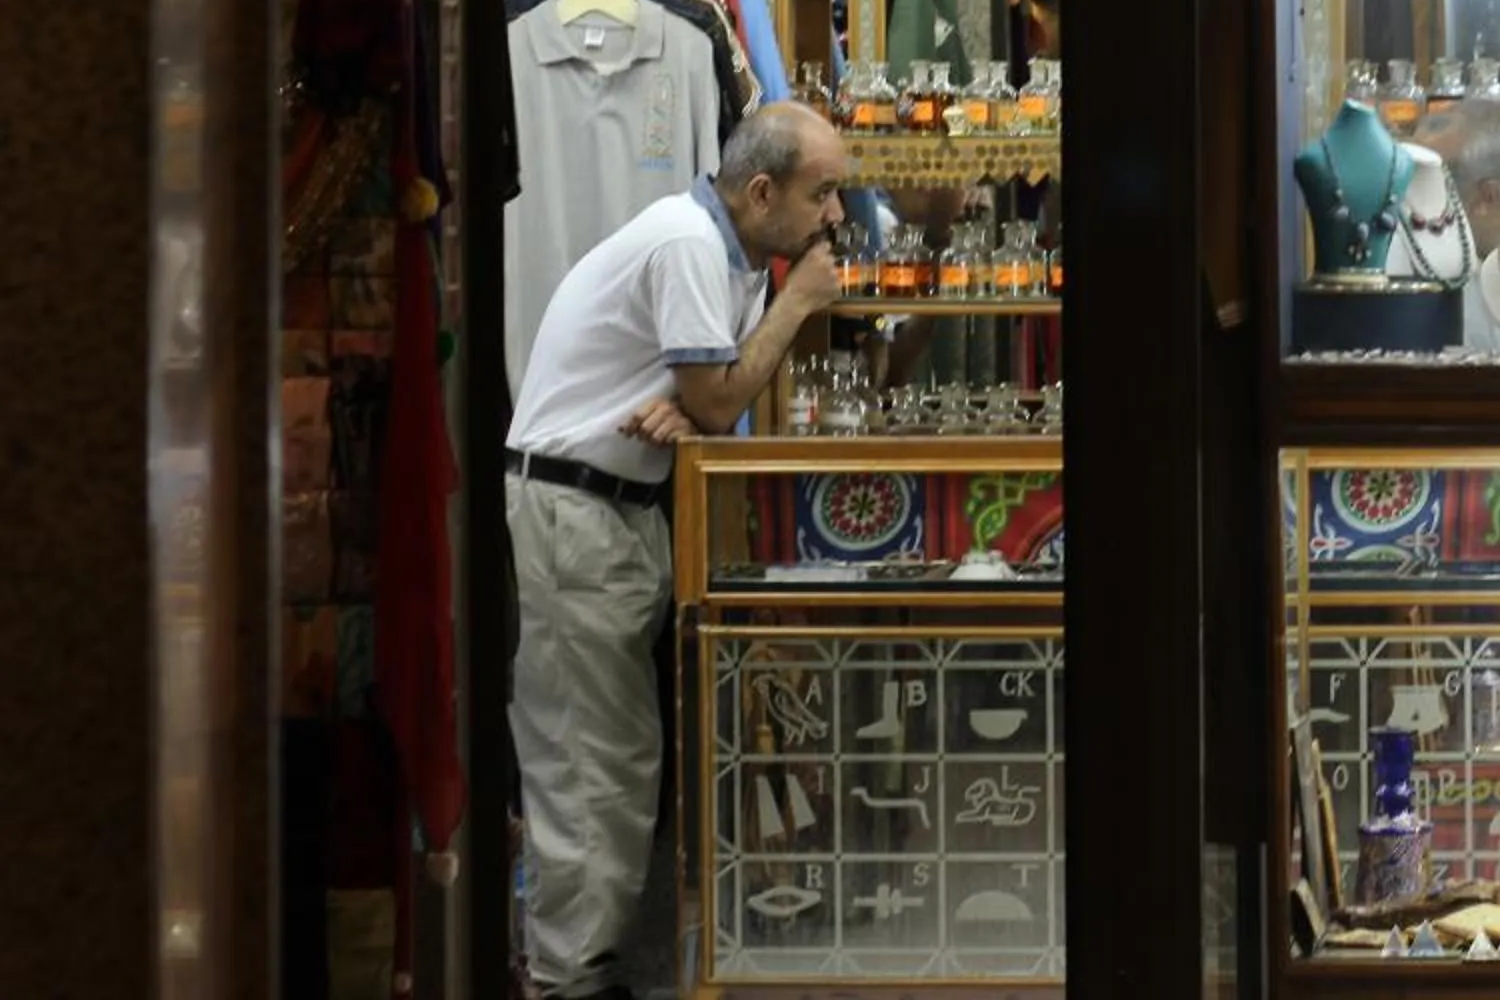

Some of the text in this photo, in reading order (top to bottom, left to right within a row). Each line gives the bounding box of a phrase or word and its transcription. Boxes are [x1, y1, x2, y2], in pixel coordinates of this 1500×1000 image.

[806, 676, 823, 704] A
[907, 680, 927, 707] B
[1000, 672, 1035, 698] CK
[1329, 672, 1345, 704] F
[1444, 671, 1461, 695] G
[816, 766, 826, 794] I
[914, 766, 931, 793] J
[1001, 766, 1019, 792] L
[806, 865, 824, 889] R
[913, 864, 929, 886] S
[1012, 864, 1040, 888] T
